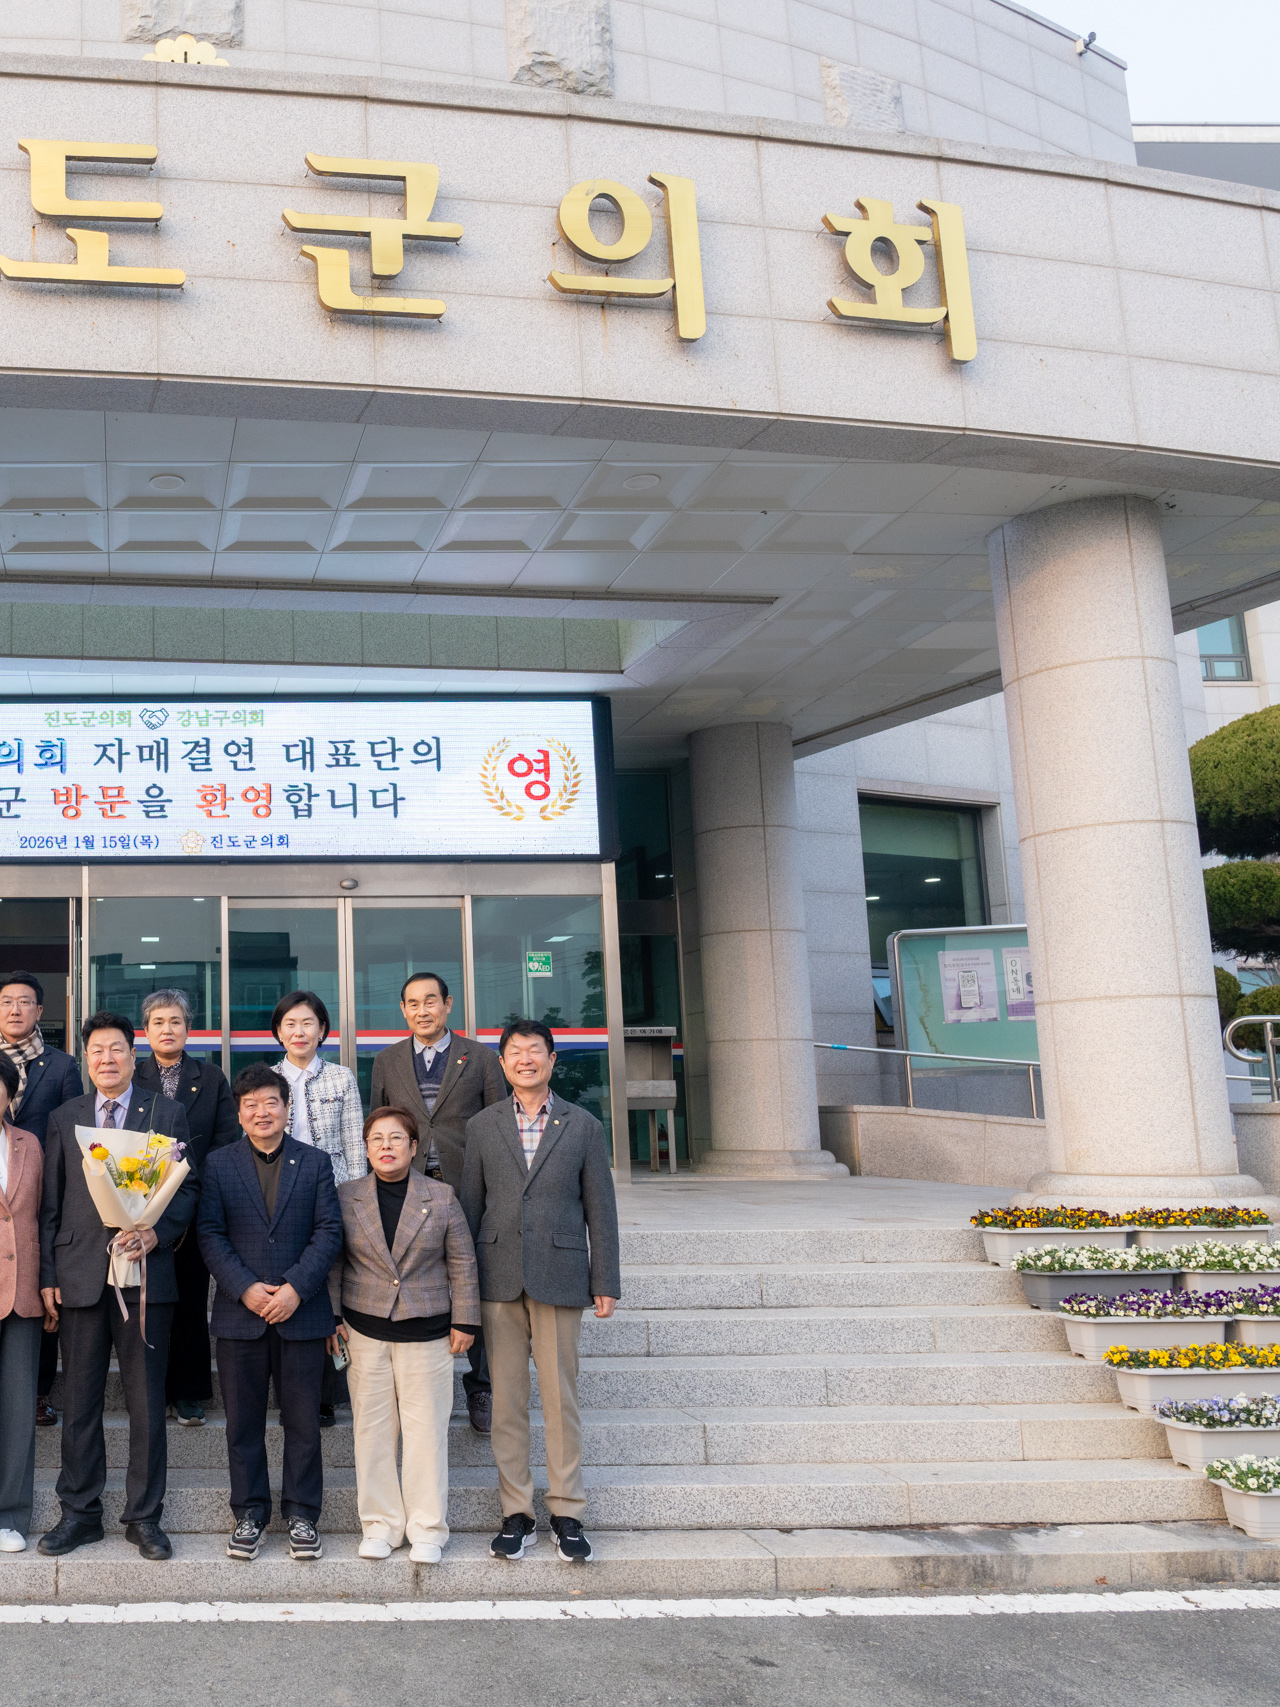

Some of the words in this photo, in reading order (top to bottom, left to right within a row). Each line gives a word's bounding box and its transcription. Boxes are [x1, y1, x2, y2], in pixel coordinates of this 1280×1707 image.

[44, 710, 132, 728] 진도군의회
[176, 709, 264, 728] 강남구의회
[93, 737, 256, 774] 자매결연
[282, 737, 442, 773] 대표단의
[507, 749, 551, 801] 영
[51, 783, 173, 820] 방문을
[195, 783, 406, 820] 환영합니다
[20, 835, 68, 850] 2026년
[75, 835, 95, 850] 1월
[102, 835, 159, 850] 15일(목)
[210, 834, 290, 849] 진도군의회
[537, 964, 551, 972] AED
